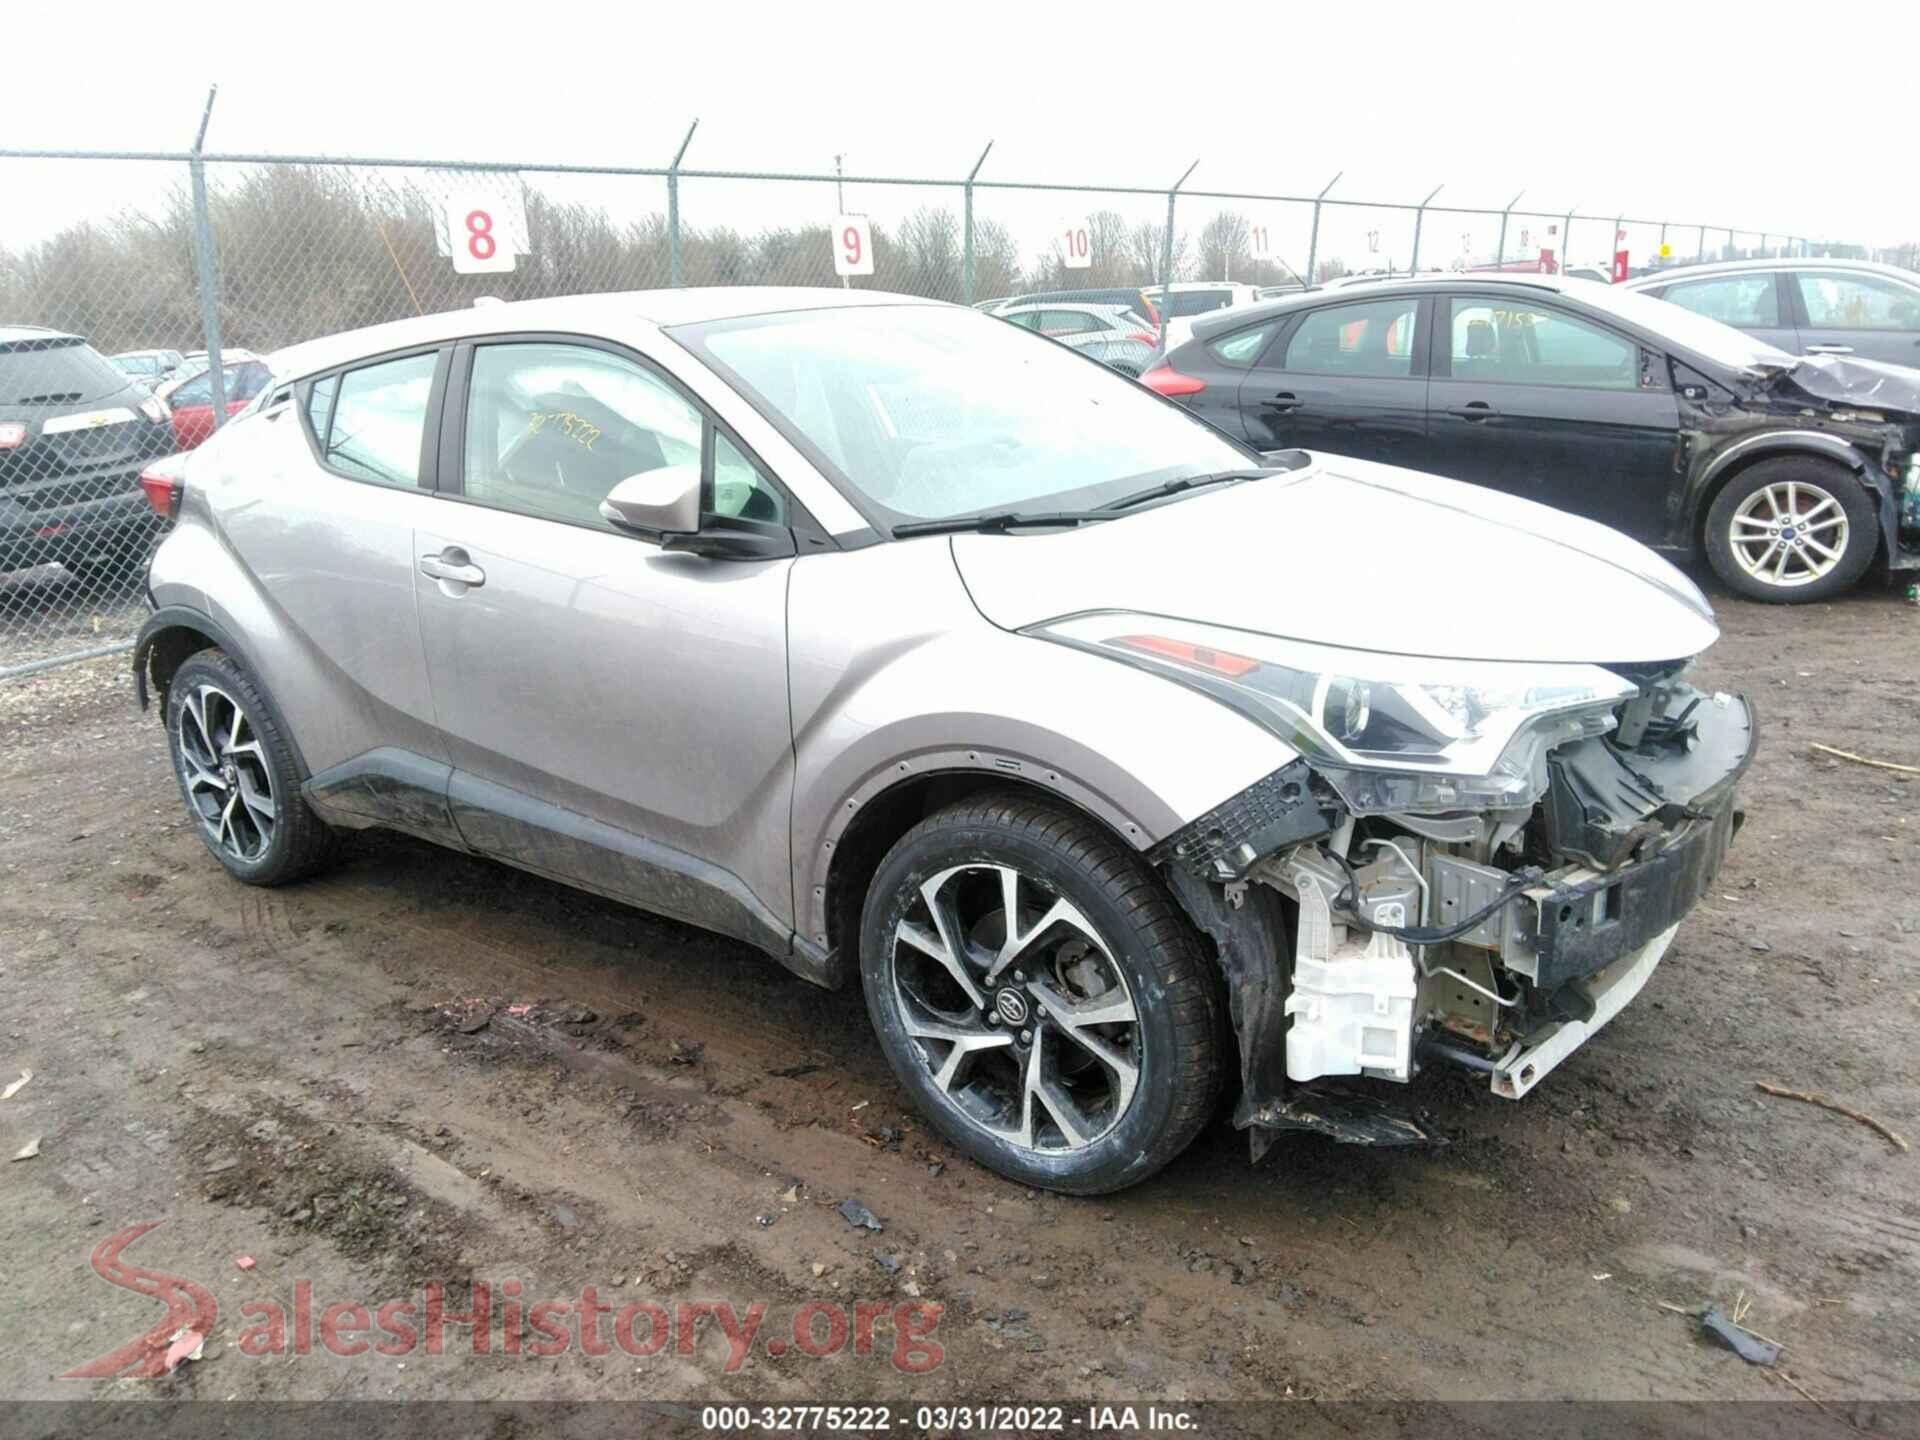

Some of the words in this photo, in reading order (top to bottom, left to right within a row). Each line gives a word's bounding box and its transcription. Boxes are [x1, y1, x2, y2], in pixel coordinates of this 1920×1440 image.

[464, 209, 497, 260] 8
[842, 226, 861, 264] 9
[1065, 228, 1088, 258] 10
[1252, 226, 1269, 252] 11
